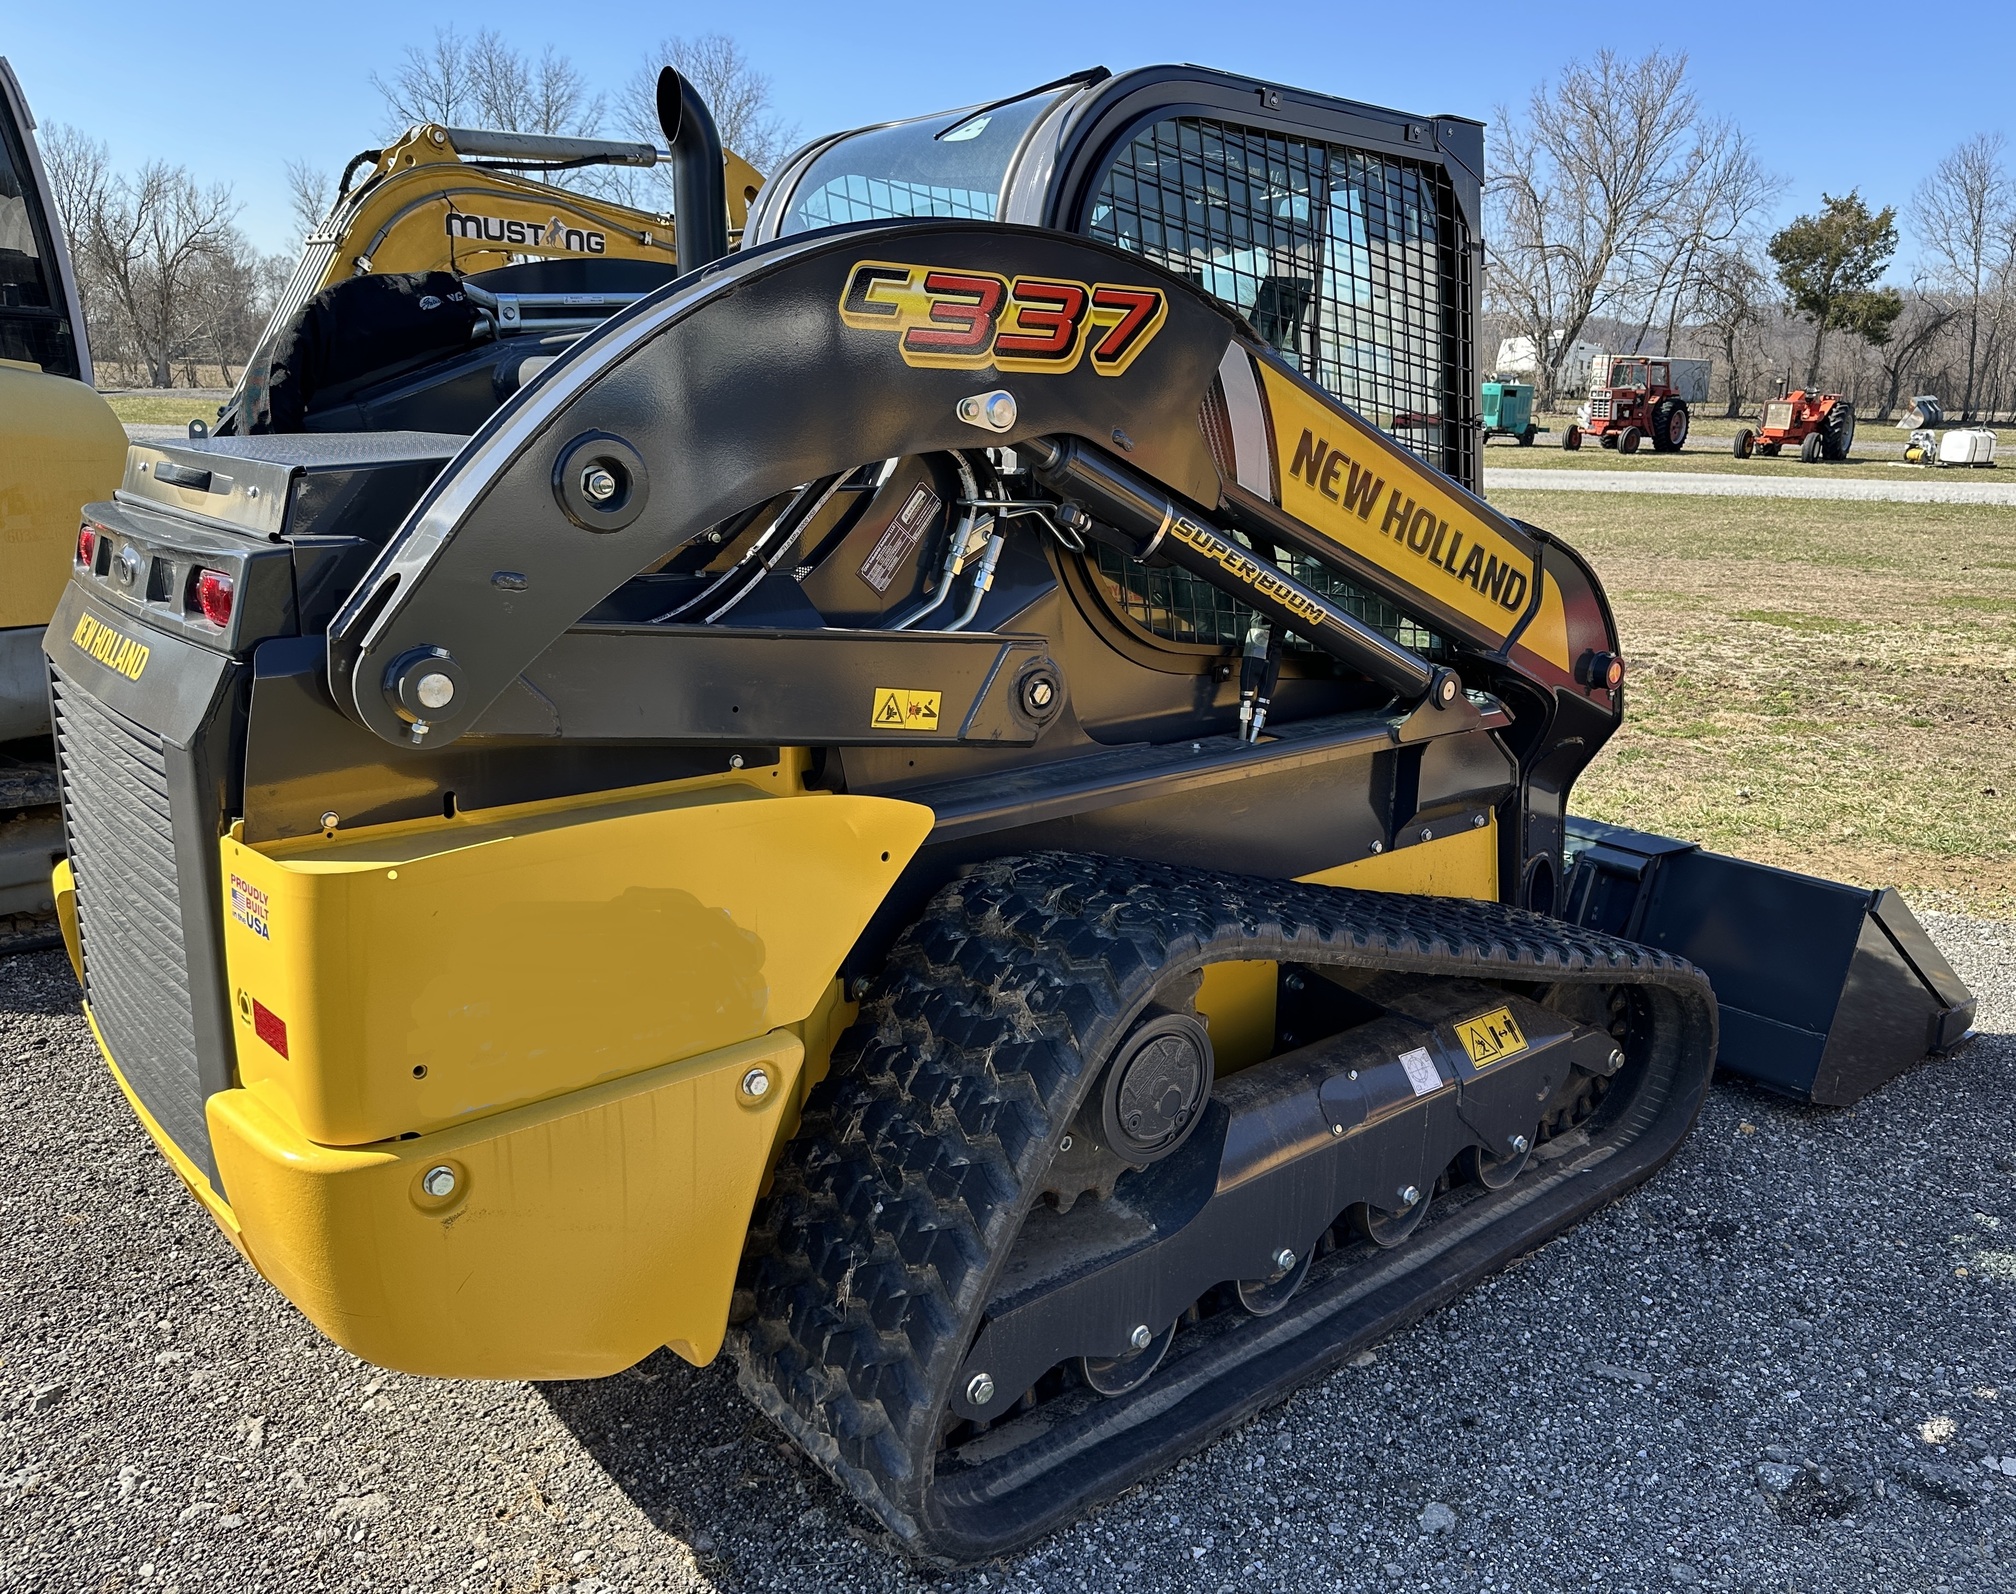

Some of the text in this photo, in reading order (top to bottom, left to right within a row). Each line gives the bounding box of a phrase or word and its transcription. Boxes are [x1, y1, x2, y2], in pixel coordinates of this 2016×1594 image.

[445, 213, 605, 254] MUSTANG
[841, 262, 1168, 373] C337
[1289, 427, 1528, 613] NEW HOLLAND
[71, 611, 150, 681] NEW HOLLAND
[230, 873, 268, 906] PROUDLY
[246, 897, 269, 921] BUILT
[246, 911, 270, 940] USA
